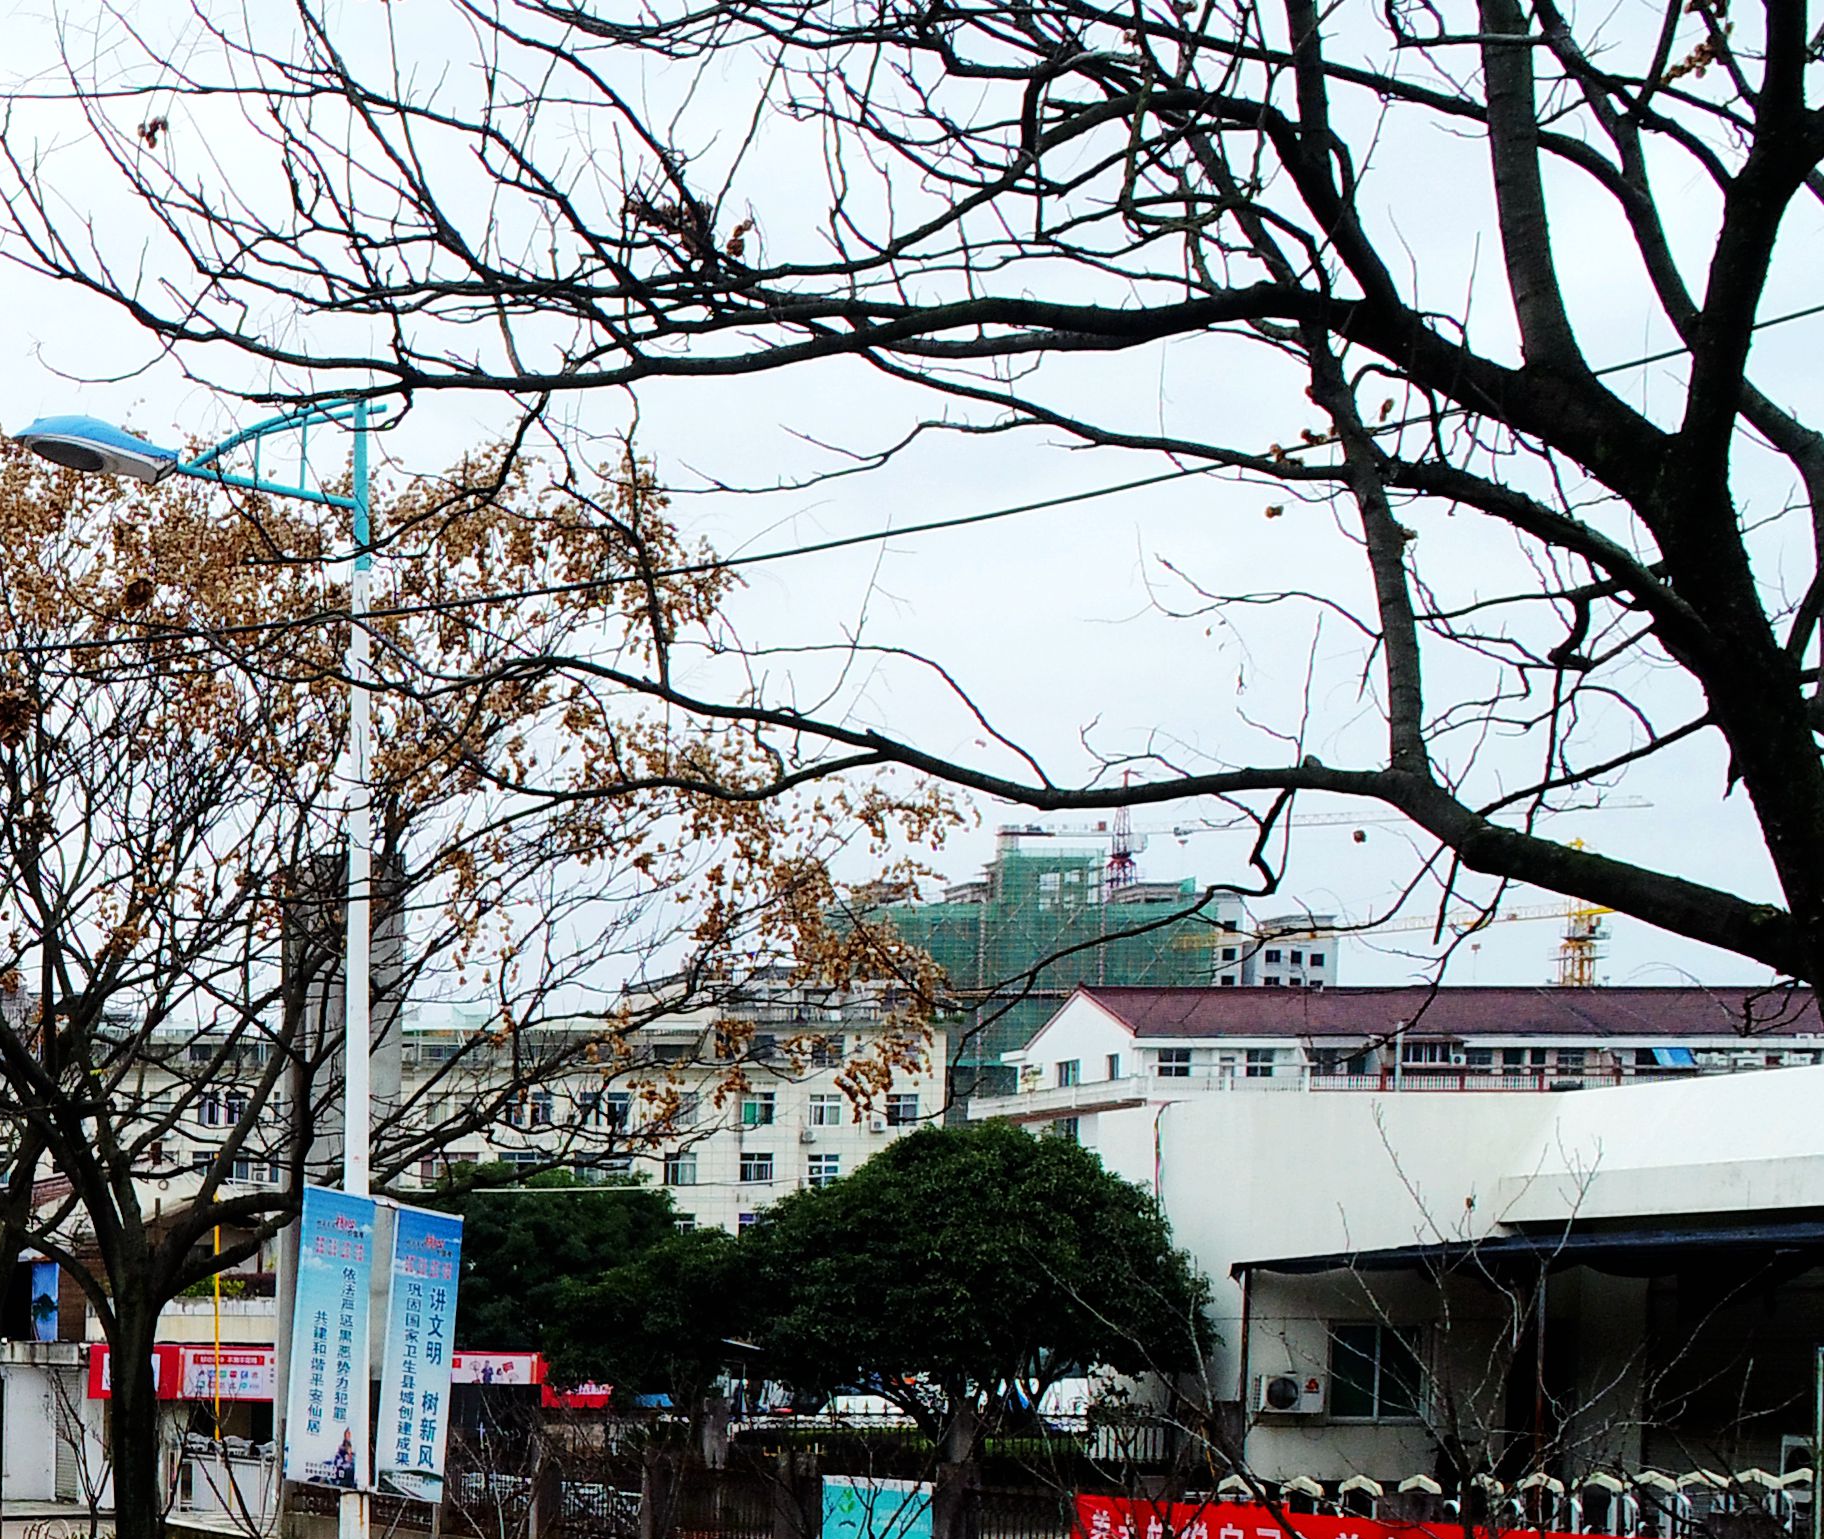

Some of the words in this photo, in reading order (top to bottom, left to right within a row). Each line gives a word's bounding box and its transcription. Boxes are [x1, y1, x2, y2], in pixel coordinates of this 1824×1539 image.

[306, 1310, 329, 1435] 共建和谐平安仙居
[333, 1265, 357, 1423] 依法严惩黑恶势力犯罪
[395, 1282, 423, 1467] 巩固国家卫生县城创建成果
[425, 1286, 447, 1367] 讲文明
[417, 1389, 440, 1470] 树新风
